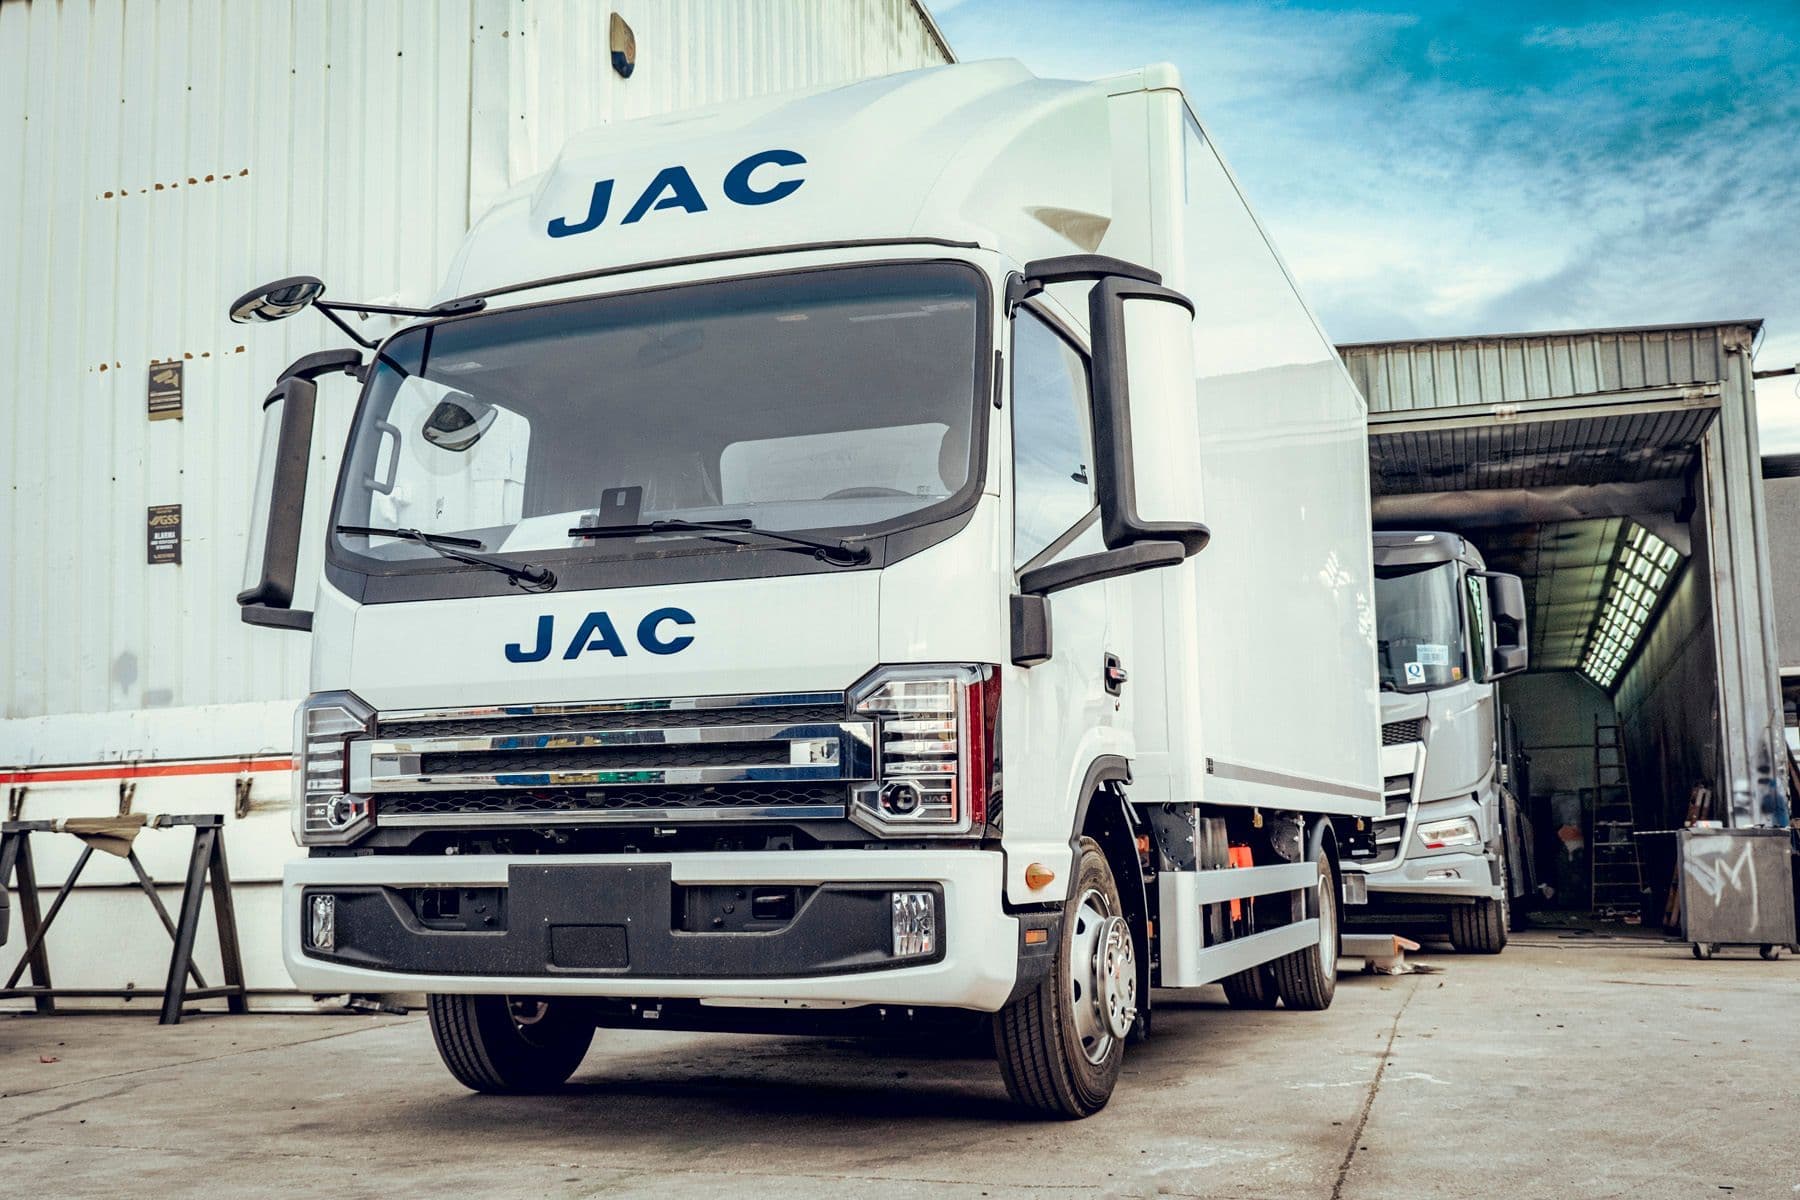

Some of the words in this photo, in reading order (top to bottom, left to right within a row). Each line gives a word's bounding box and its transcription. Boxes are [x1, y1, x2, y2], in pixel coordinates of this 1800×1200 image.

[547, 150, 807, 238] JAC
[505, 608, 695, 662] JAC
[1408, 664, 1421, 678] Q
[924, 795, 948, 803] JAC
